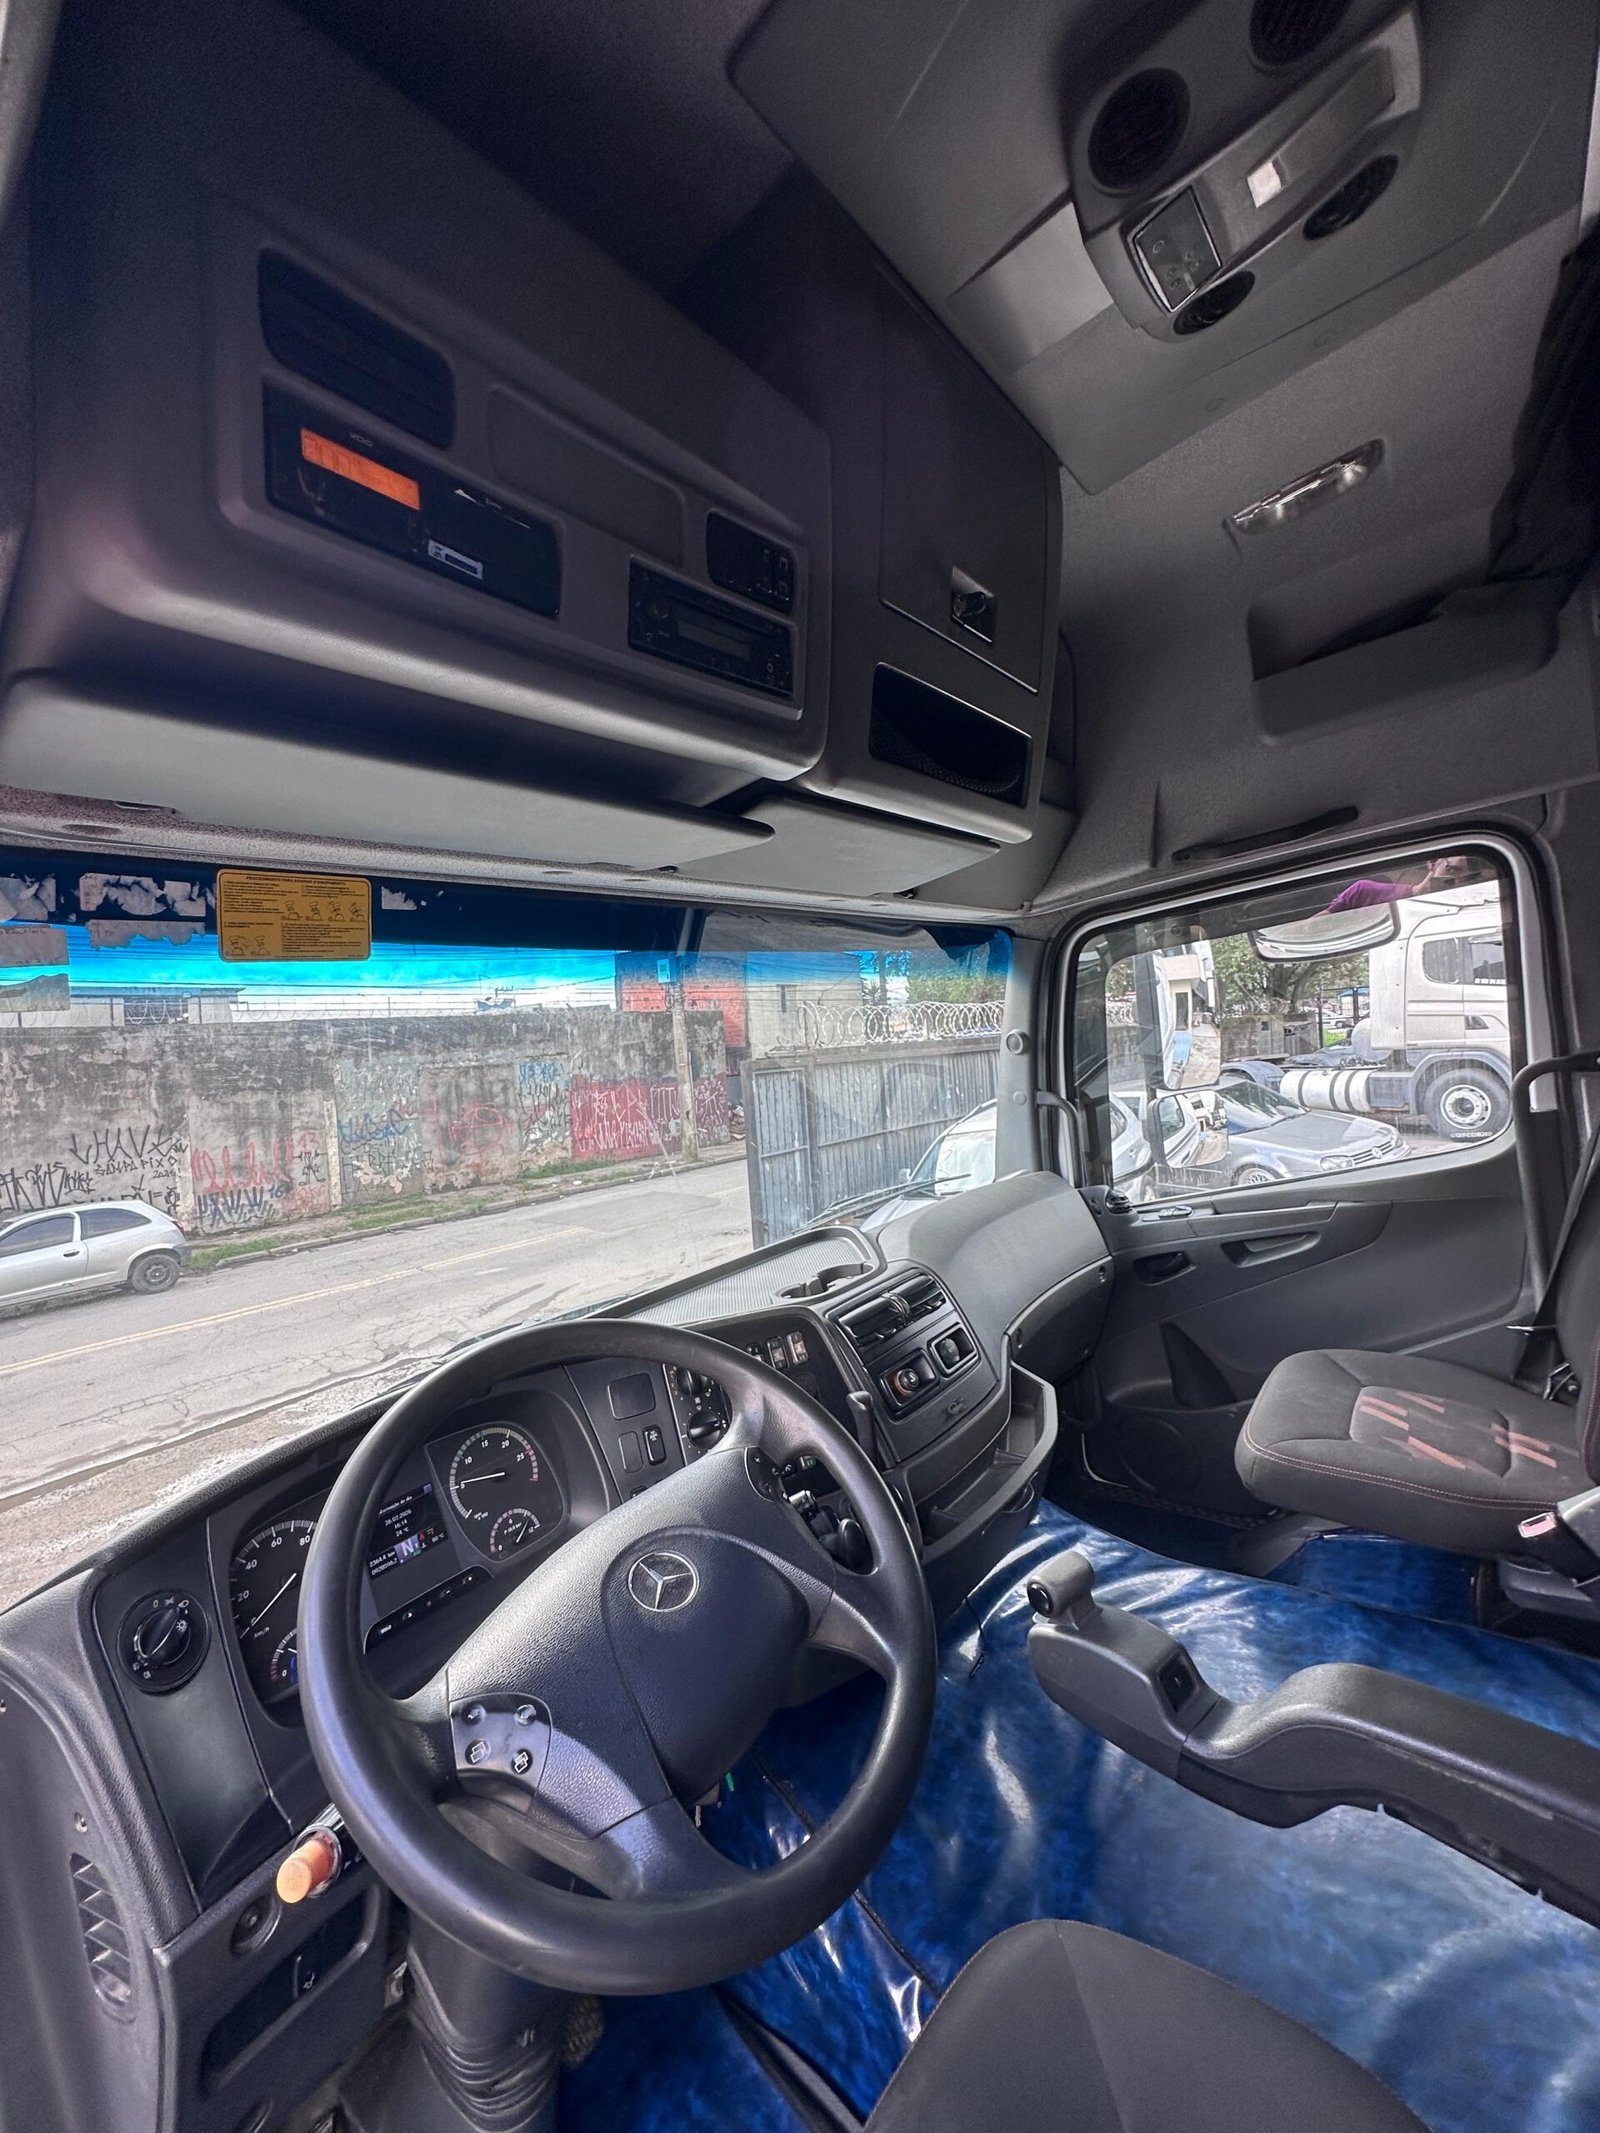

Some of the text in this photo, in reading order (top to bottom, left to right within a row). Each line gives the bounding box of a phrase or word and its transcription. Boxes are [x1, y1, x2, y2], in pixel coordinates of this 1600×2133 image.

[502, 1440, 510, 1448] 20
[465, 1456, 472, 1464] 10
[516, 1453, 524, 1462] 25
[271, 1536, 282, 1548] 60
[300, 1535, 311, 1546] 80
[246, 1559, 258, 1570] 40
[238, 1590, 249, 1602] 20
